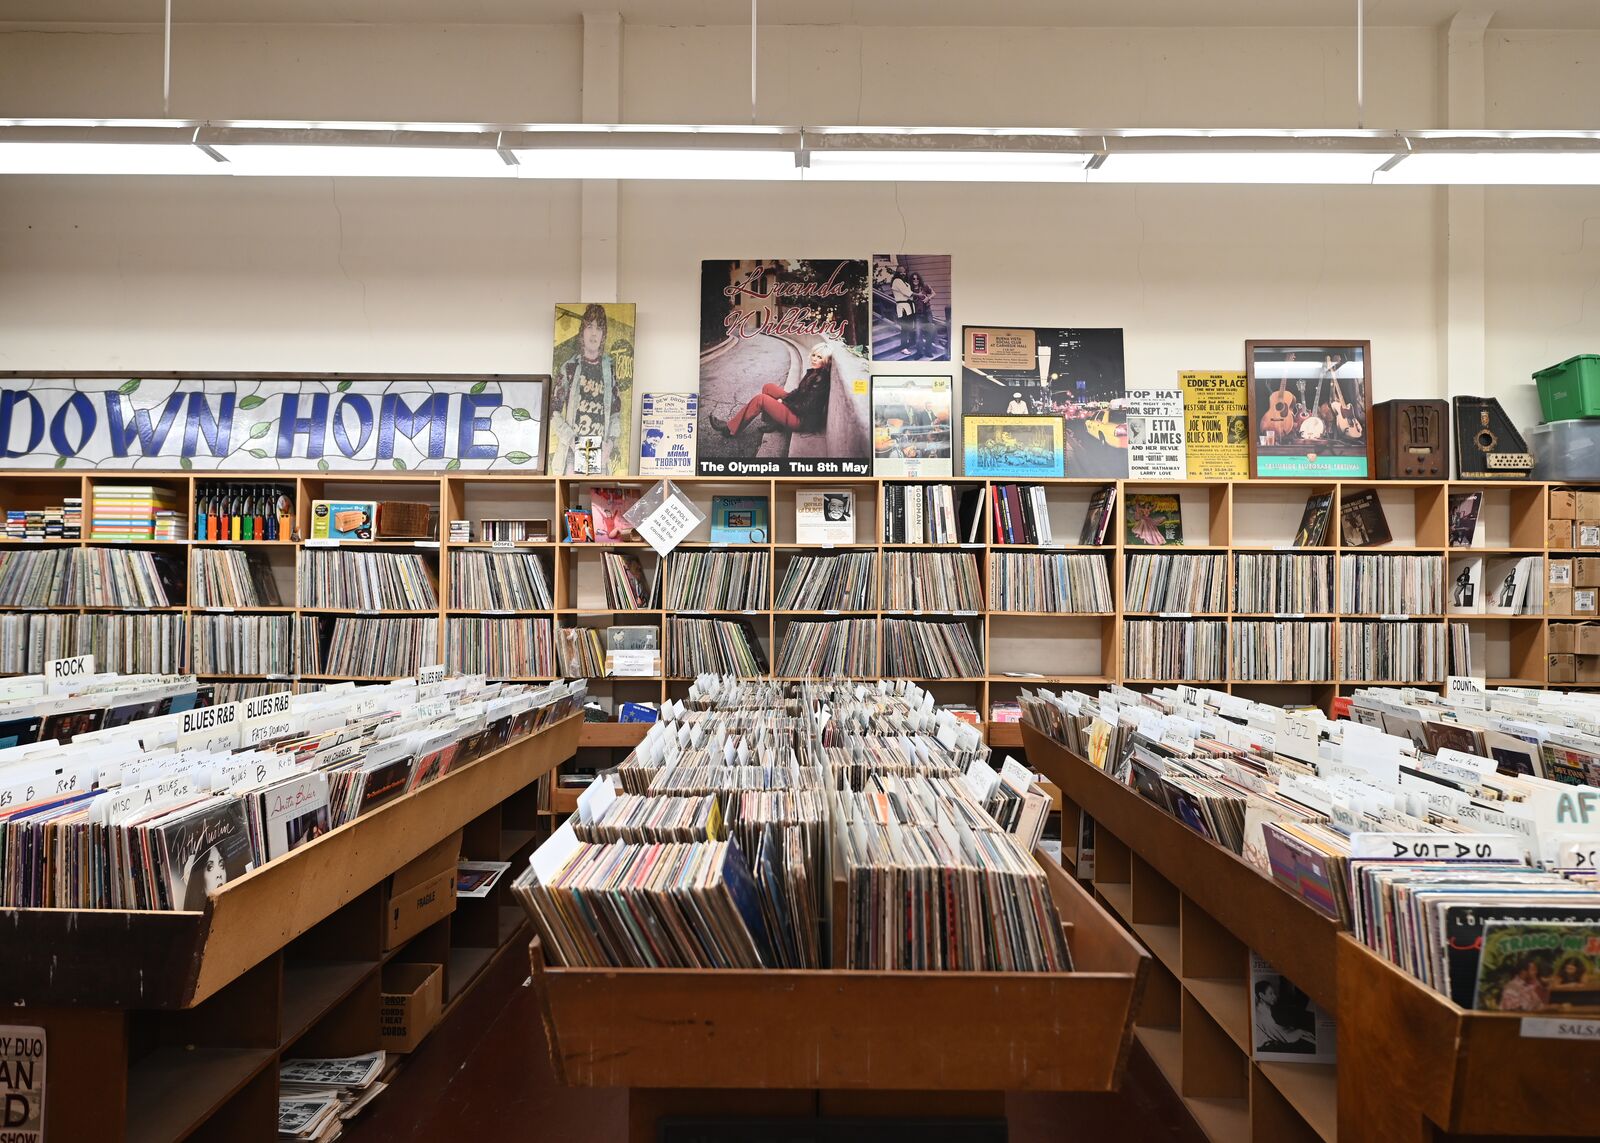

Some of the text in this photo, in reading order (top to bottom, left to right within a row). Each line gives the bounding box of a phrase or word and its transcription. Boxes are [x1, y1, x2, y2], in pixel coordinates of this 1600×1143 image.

[724, 261, 849, 298] Lucinda
[724, 307, 848, 339] Williams
[0, 387, 237, 459] DOWN
[275, 391, 504, 461] HOME
[687, 423, 693, 433] 5
[1152, 420, 1176, 431] ETTA
[1189, 420, 1221, 431] JOE YOUNG
[1148, 433, 1182, 444] JAMES
[1186, 432, 1223, 443] BLUES BAND
[655, 458, 691, 466] THORNTON
[700, 461, 727, 472] The
[728, 461, 780, 473] Olympia
[789, 461, 814, 472] Thu
[817, 461, 838, 472] 8th
[842, 462, 868, 474] May
[665, 509, 684, 529] SLEEVES
[677, 510, 690, 523] POLY
[650, 527, 666, 542] counter
[55, 657, 85, 677] ROCK
[421, 670, 443, 684] BLUES R&B
[1453, 680, 1480, 692] COUNT
[1183, 688, 1197, 706] JAZZ
[247, 695, 289, 718] BLUES R&B
[184, 705, 235, 732] BLUES R&B
[251, 728, 268, 742] FATS
[1284, 717, 1311, 739] JAZZ
[323, 746, 352, 764] RAY CHARLES
[231, 771, 247, 786] BLUES
[256, 764, 267, 783] B
[26, 786, 35, 801] B
[158, 779, 179, 795] BLUES
[113, 789, 152, 815] MISC A
[271, 784, 317, 816] Anita Baker
[1557, 792, 1600, 824] AF
[1484, 813, 1529, 836] MULLIGAN
[195, 818, 235, 855] Austin
[1392, 840, 1491, 858] SALSA
[417, 891, 435, 909] FRAGILE
[1499, 934, 1560, 954] TRAIGO
[385, 997, 406, 1006] DROP
[385, 1016, 402, 1024] HEAT
[1558, 1023, 1600, 1036] SALSA
[15, 1038, 42, 1057] DUO
[0, 1094, 29, 1127] D
[0, 1133, 37, 1143] SHOW
